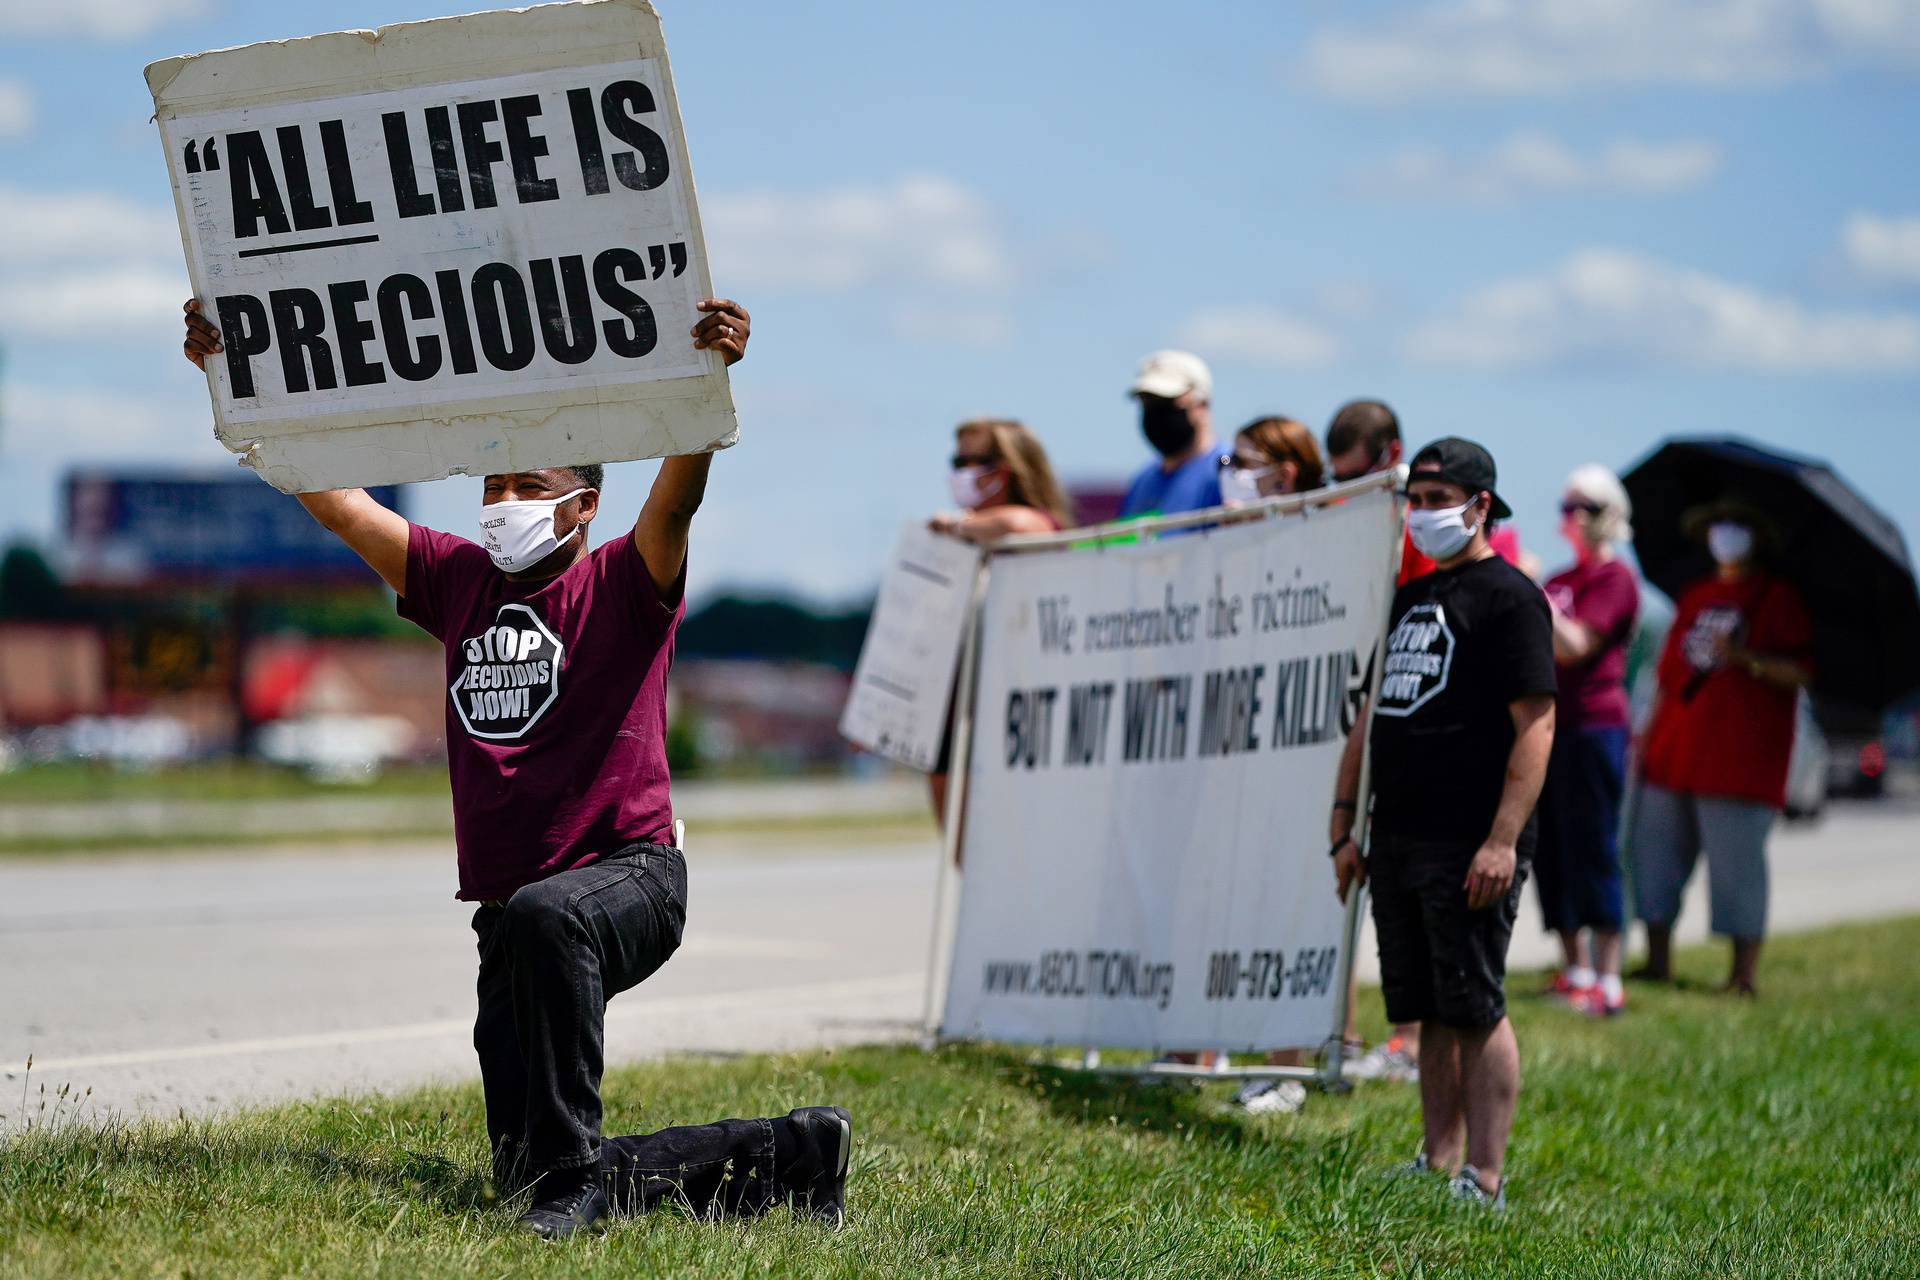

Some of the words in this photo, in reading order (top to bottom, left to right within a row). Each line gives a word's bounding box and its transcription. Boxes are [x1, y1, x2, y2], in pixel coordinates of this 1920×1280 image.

[381, 95, 559, 219] LIFE
[566, 80, 670, 196] IS
[215, 242, 688, 399] PRECIOUS”
[484, 541, 502, 553] DEATH
[1037, 595, 1073, 654] We
[1084, 583, 1199, 653] remember
[1207, 574, 1243, 640] the
[466, 626, 542, 662] STOP
[463, 660, 549, 690] ECUTIONS
[470, 688, 530, 720] NOW!
[1006, 686, 1059, 770] BUT
[1064, 679, 1116, 768] NOT
[1122, 673, 1193, 764] WITH
[1198, 663, 1266, 758] MORE
